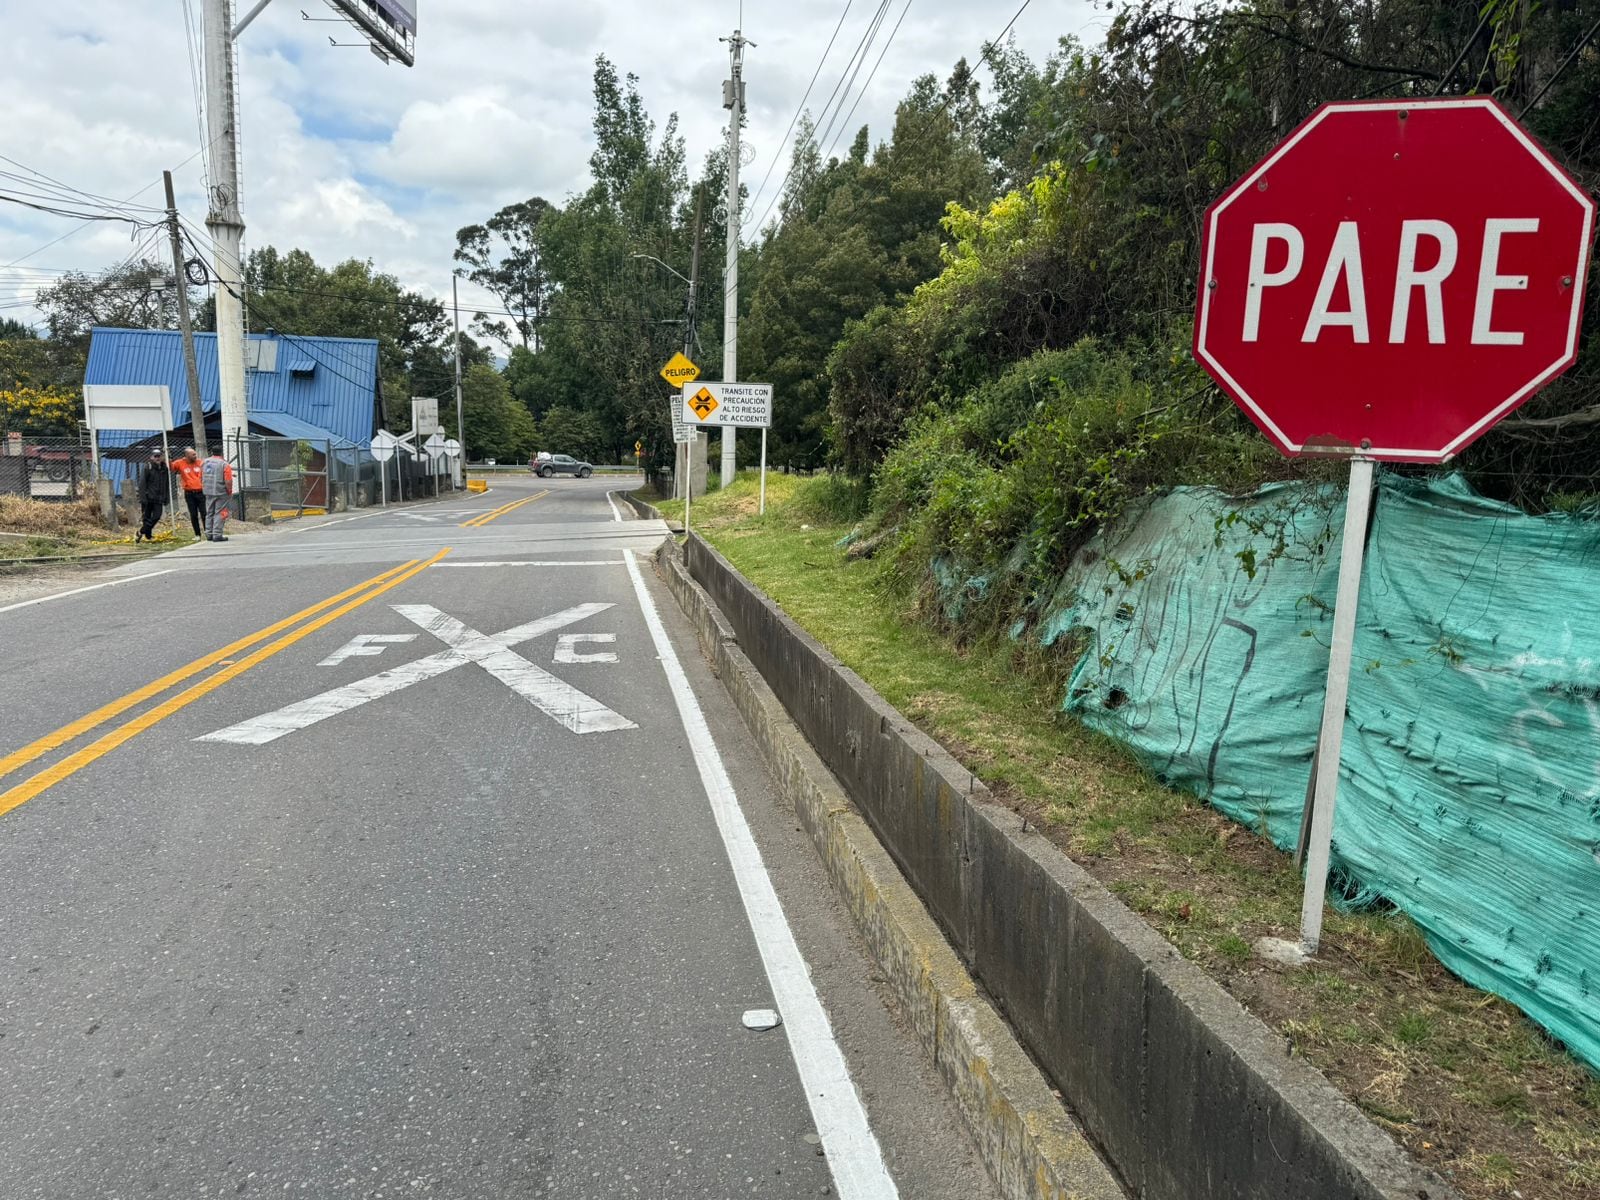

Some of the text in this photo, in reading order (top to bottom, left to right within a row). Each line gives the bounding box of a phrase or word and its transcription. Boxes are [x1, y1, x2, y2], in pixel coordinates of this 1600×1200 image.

[1242, 218, 1540, 345] PARE
[665, 368, 696, 377] PELIGRO
[721, 387, 769, 396] TRANSITE CON
[723, 395, 765, 405] PRECAUCIÓN
[722, 405, 766, 414] ALTO RIESGO
[719, 414, 768, 423] DE ACCIDENTE
